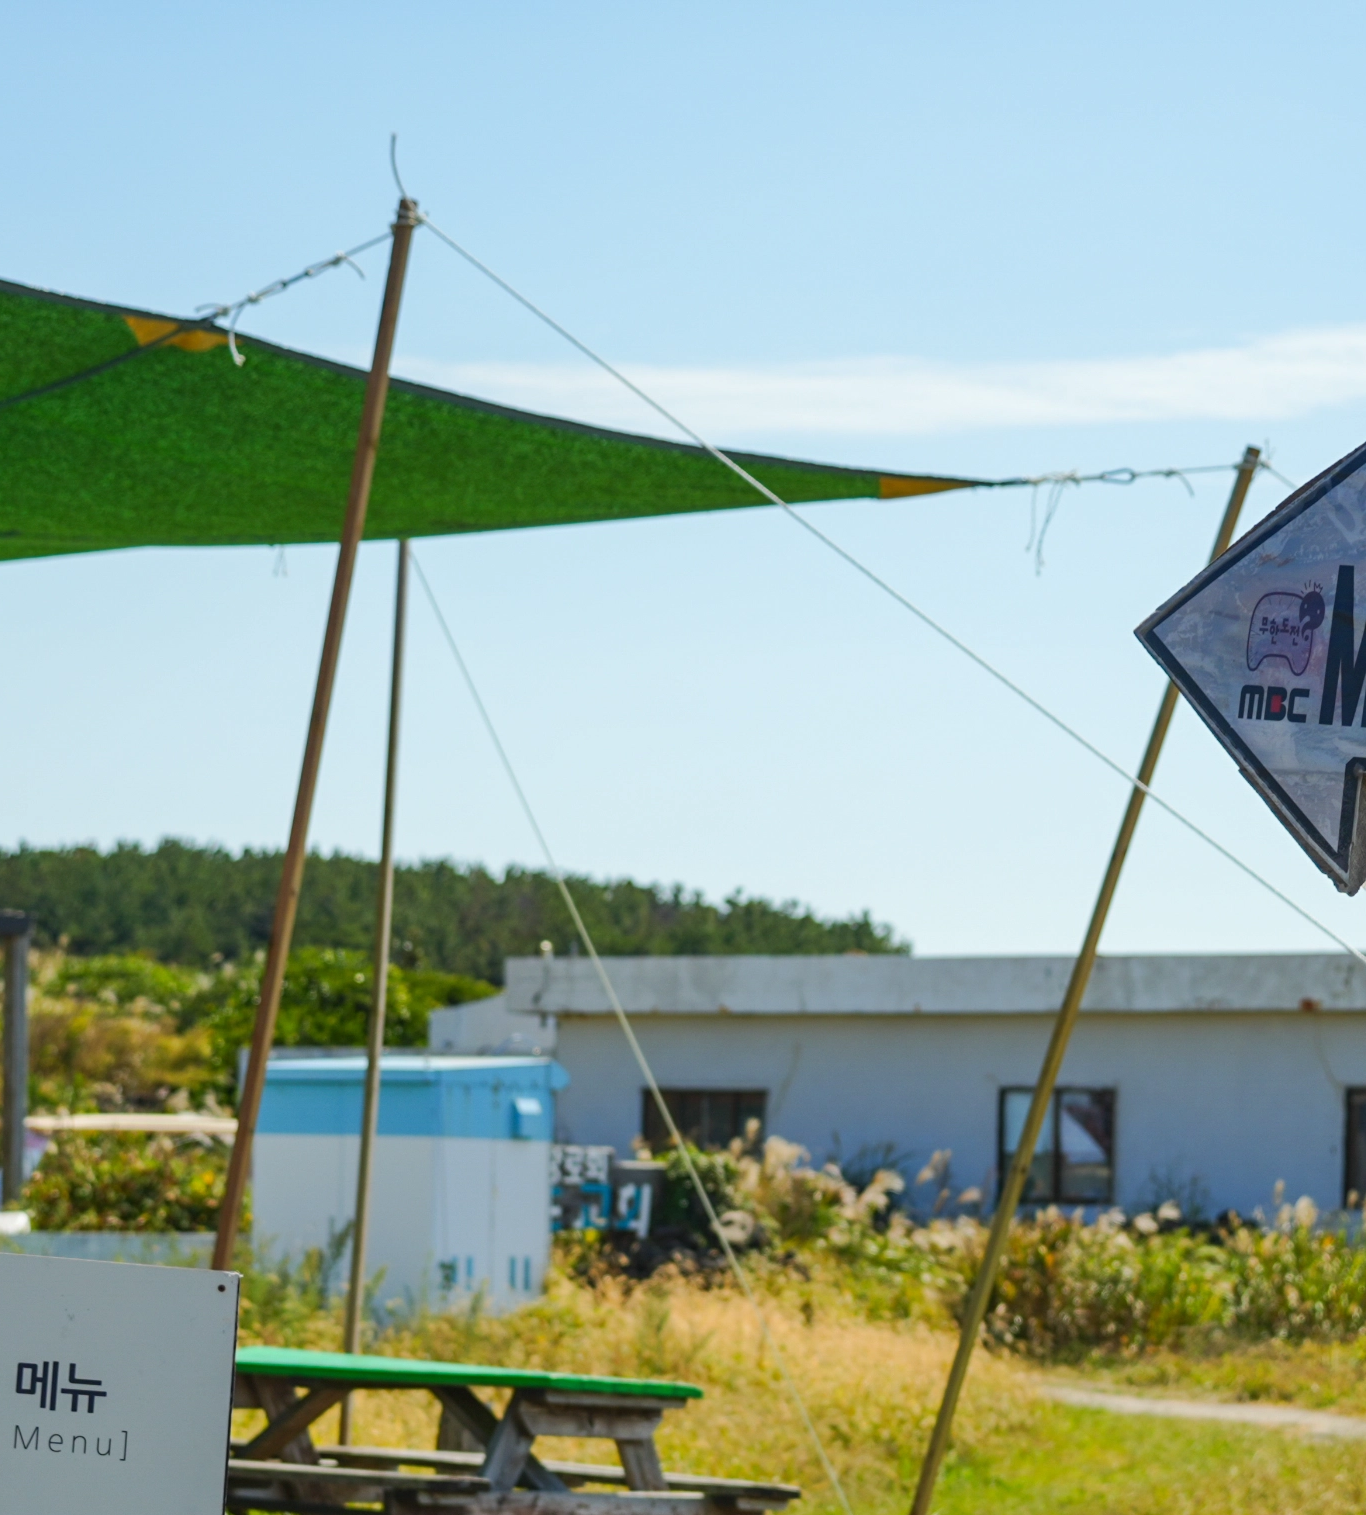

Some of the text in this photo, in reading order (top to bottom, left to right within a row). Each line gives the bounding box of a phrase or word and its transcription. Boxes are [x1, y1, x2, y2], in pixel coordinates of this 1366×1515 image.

[1259, 616, 1300, 646] 무한도전
[1238, 684, 1311, 723] MBC
[14, 1360, 108, 1414] 메뉴
[12, 1424, 129, 1462] Menu]
